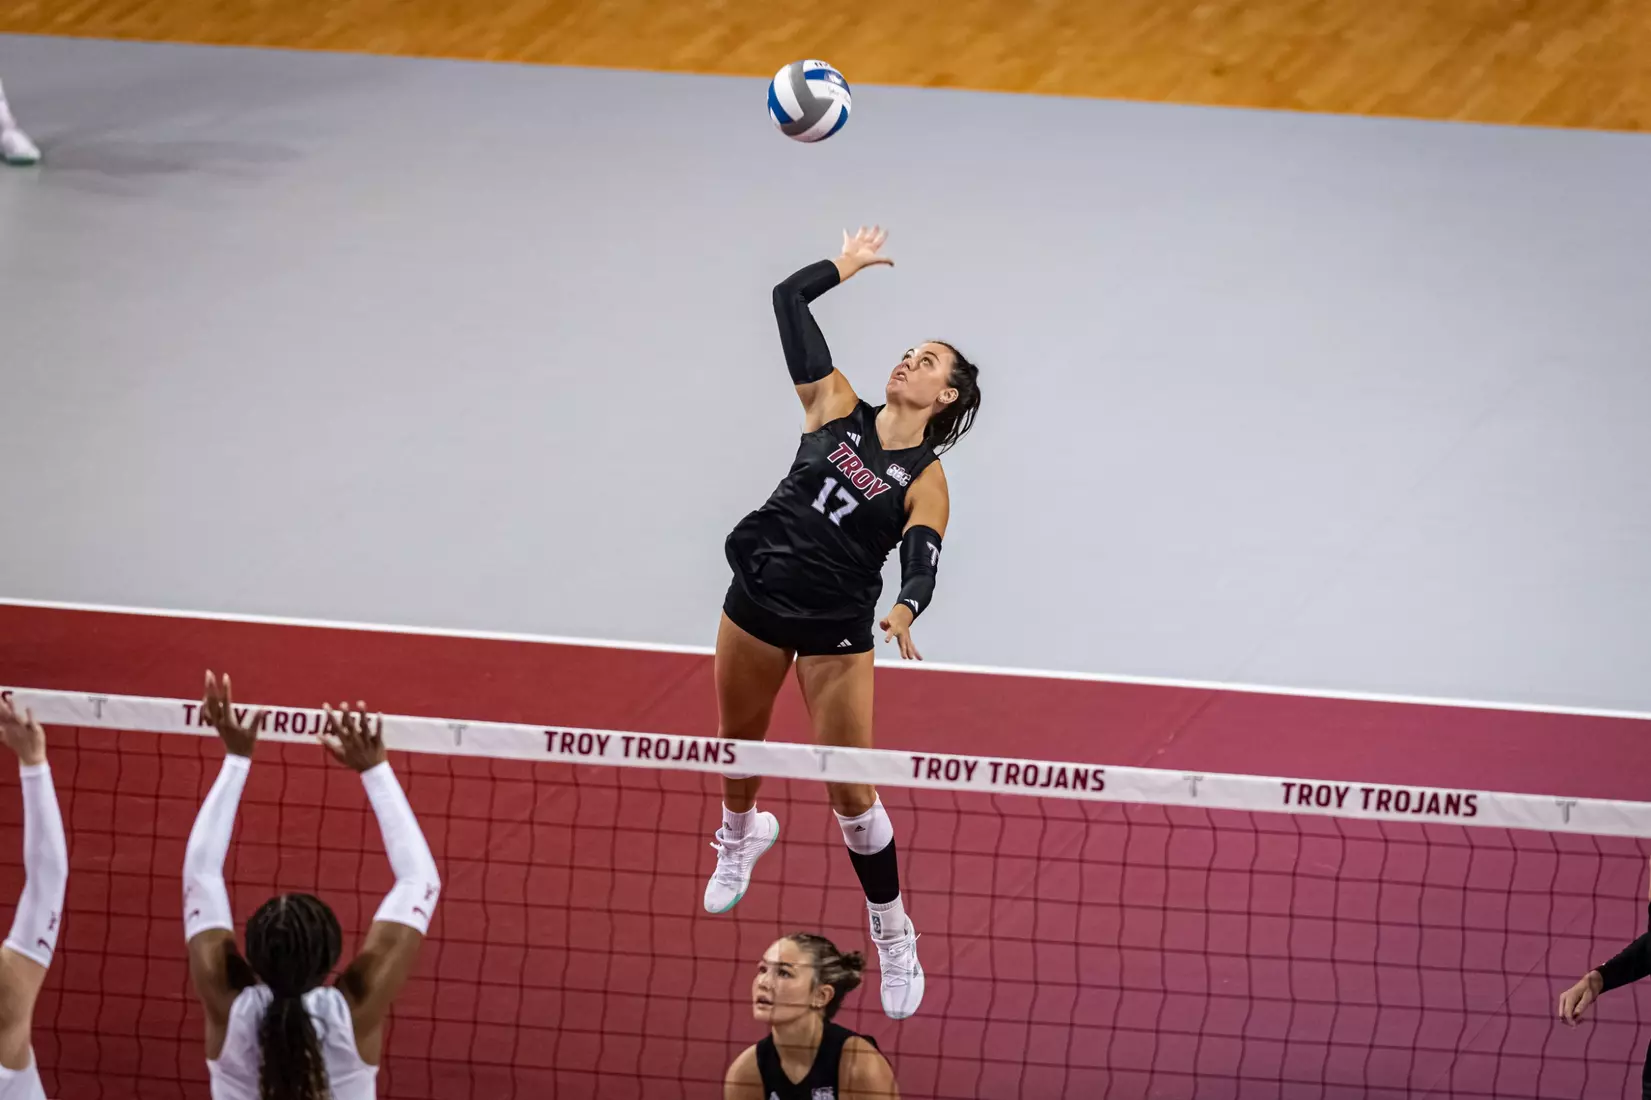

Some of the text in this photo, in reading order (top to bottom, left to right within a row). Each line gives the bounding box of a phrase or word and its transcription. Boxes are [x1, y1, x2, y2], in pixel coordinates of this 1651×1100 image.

[827, 441, 891, 501] TROY
[811, 476, 860, 527] 17
[183, 704, 248, 728] TY
[544, 730, 736, 764] TROY TROJANS
[911, 756, 1105, 792] TROY TROJANS
[1282, 782, 1478, 818] TROY TROJANS
